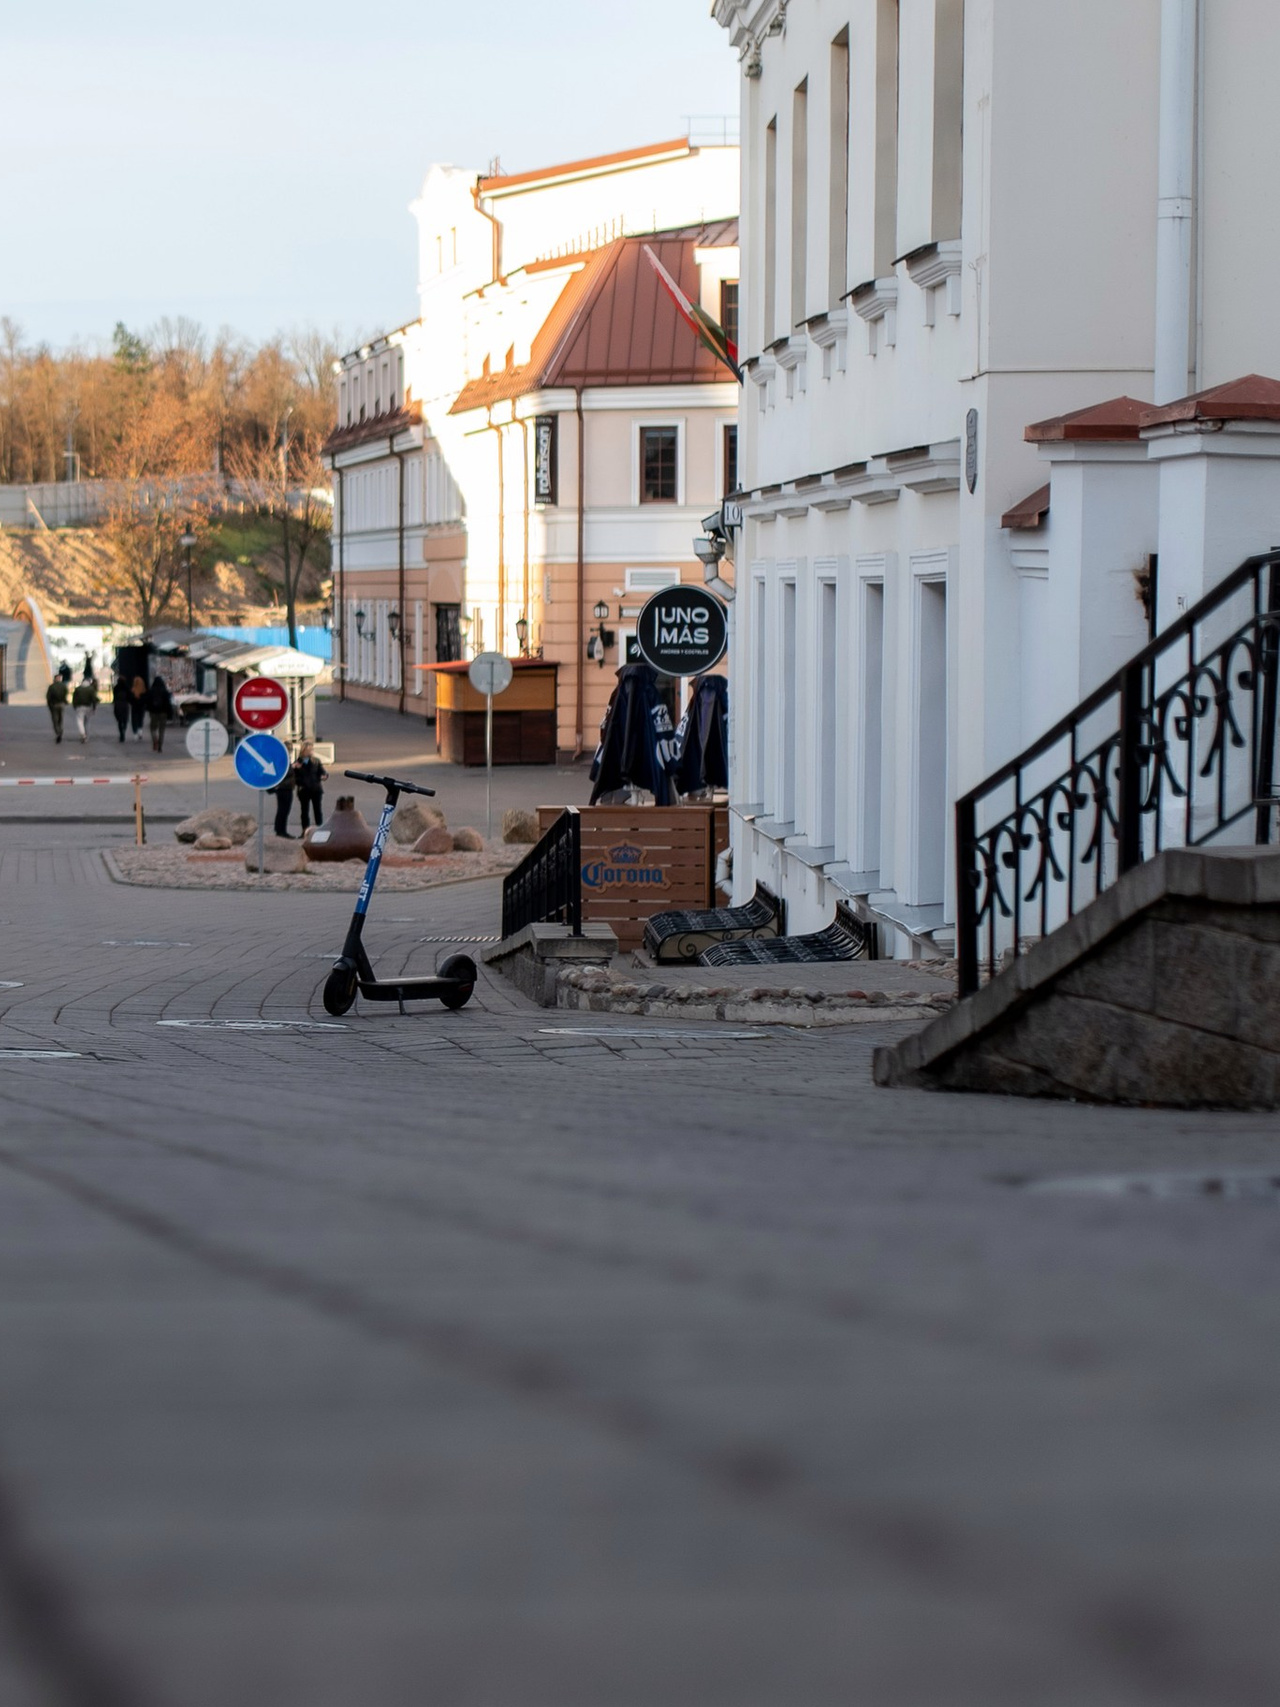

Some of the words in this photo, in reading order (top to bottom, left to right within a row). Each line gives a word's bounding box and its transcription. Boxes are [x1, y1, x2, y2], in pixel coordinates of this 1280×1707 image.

[536, 425, 550, 494] robinson
[726, 505, 740, 520] 10
[661, 607, 709, 624] UNO
[661, 625, 710, 644] MÁS
[581, 861, 663, 887] Corona
[359, 879, 369, 901] JET
